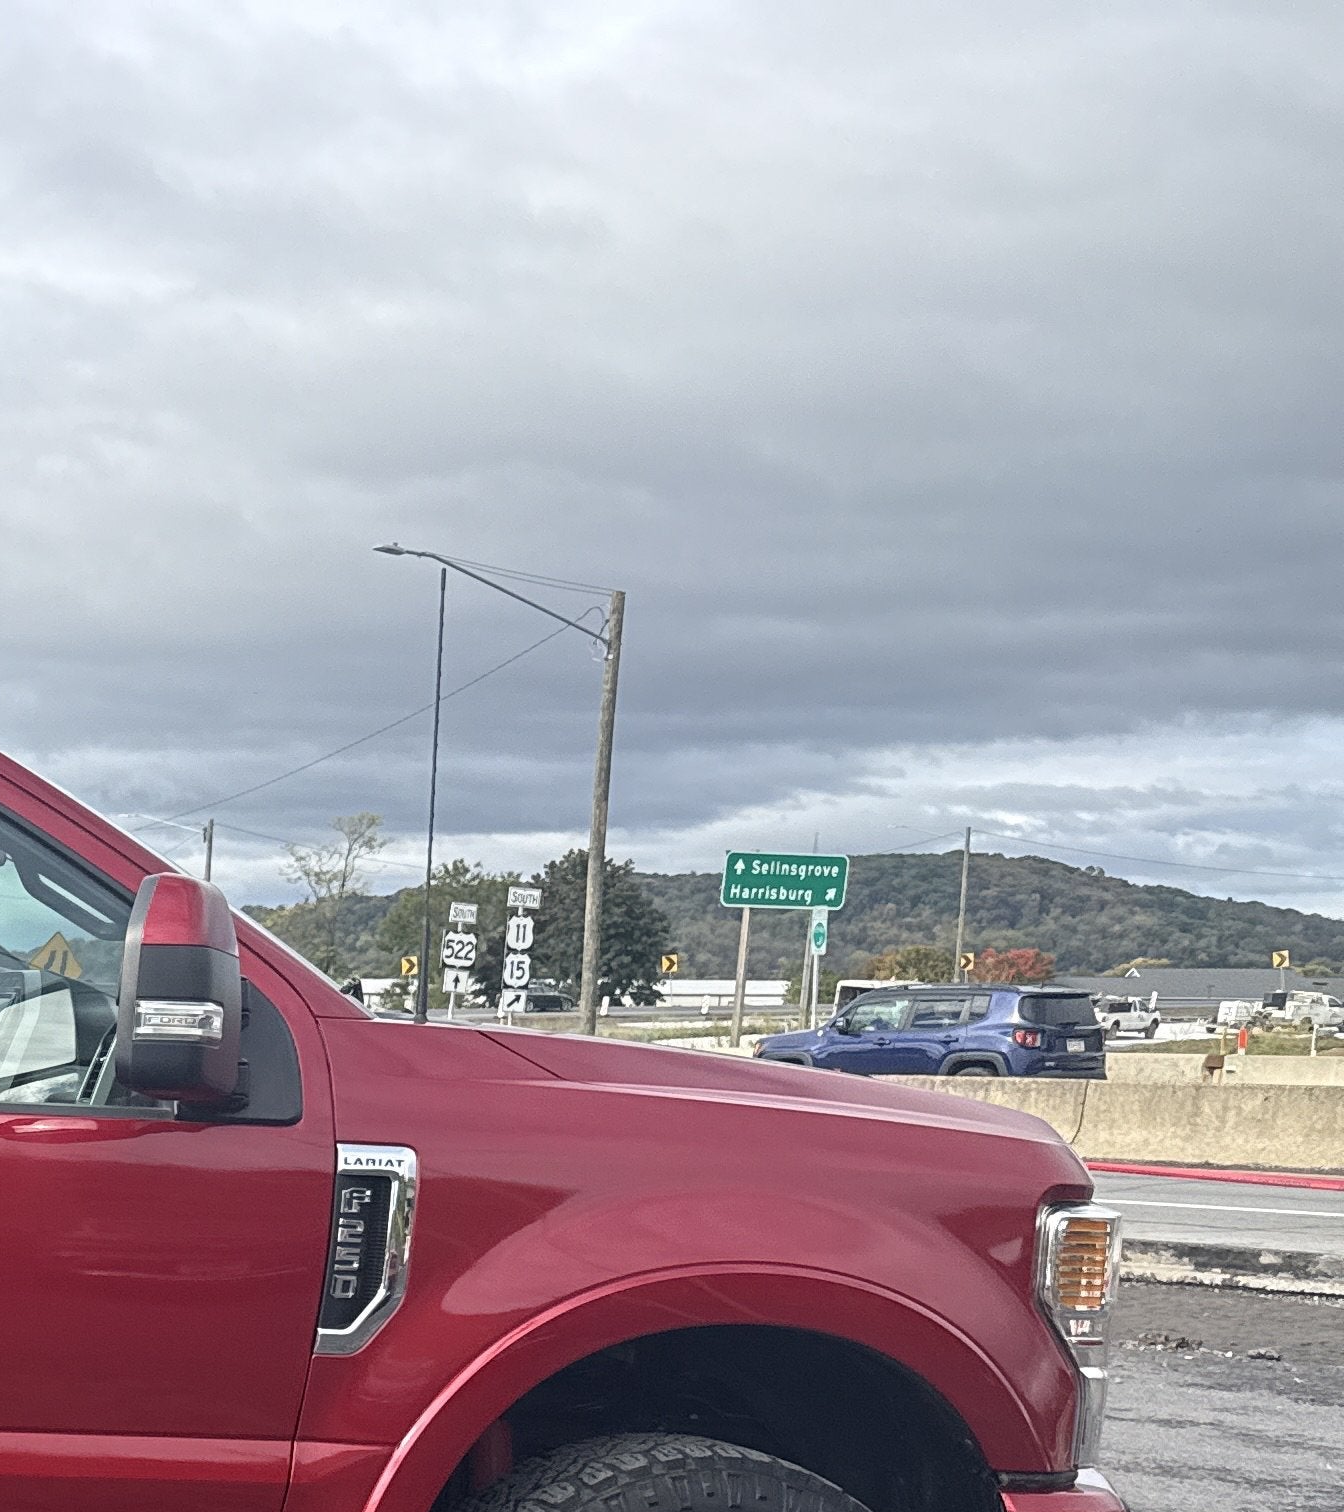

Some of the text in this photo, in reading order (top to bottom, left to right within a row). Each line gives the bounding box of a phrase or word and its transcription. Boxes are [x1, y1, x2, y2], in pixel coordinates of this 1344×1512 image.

[751, 859, 839, 880] Selinsgrove
[511, 890, 539, 904] SOUTH
[730, 884, 812, 905] Harrisburg
[452, 906, 475, 920] SOUTH
[515, 923, 527, 943] 11
[444, 940, 475, 961] 522
[510, 960, 526, 980] 15
[147, 1016, 196, 1025] FORD
[344, 1156, 405, 1168] LARIAT
[330, 1187, 372, 1299] F250
